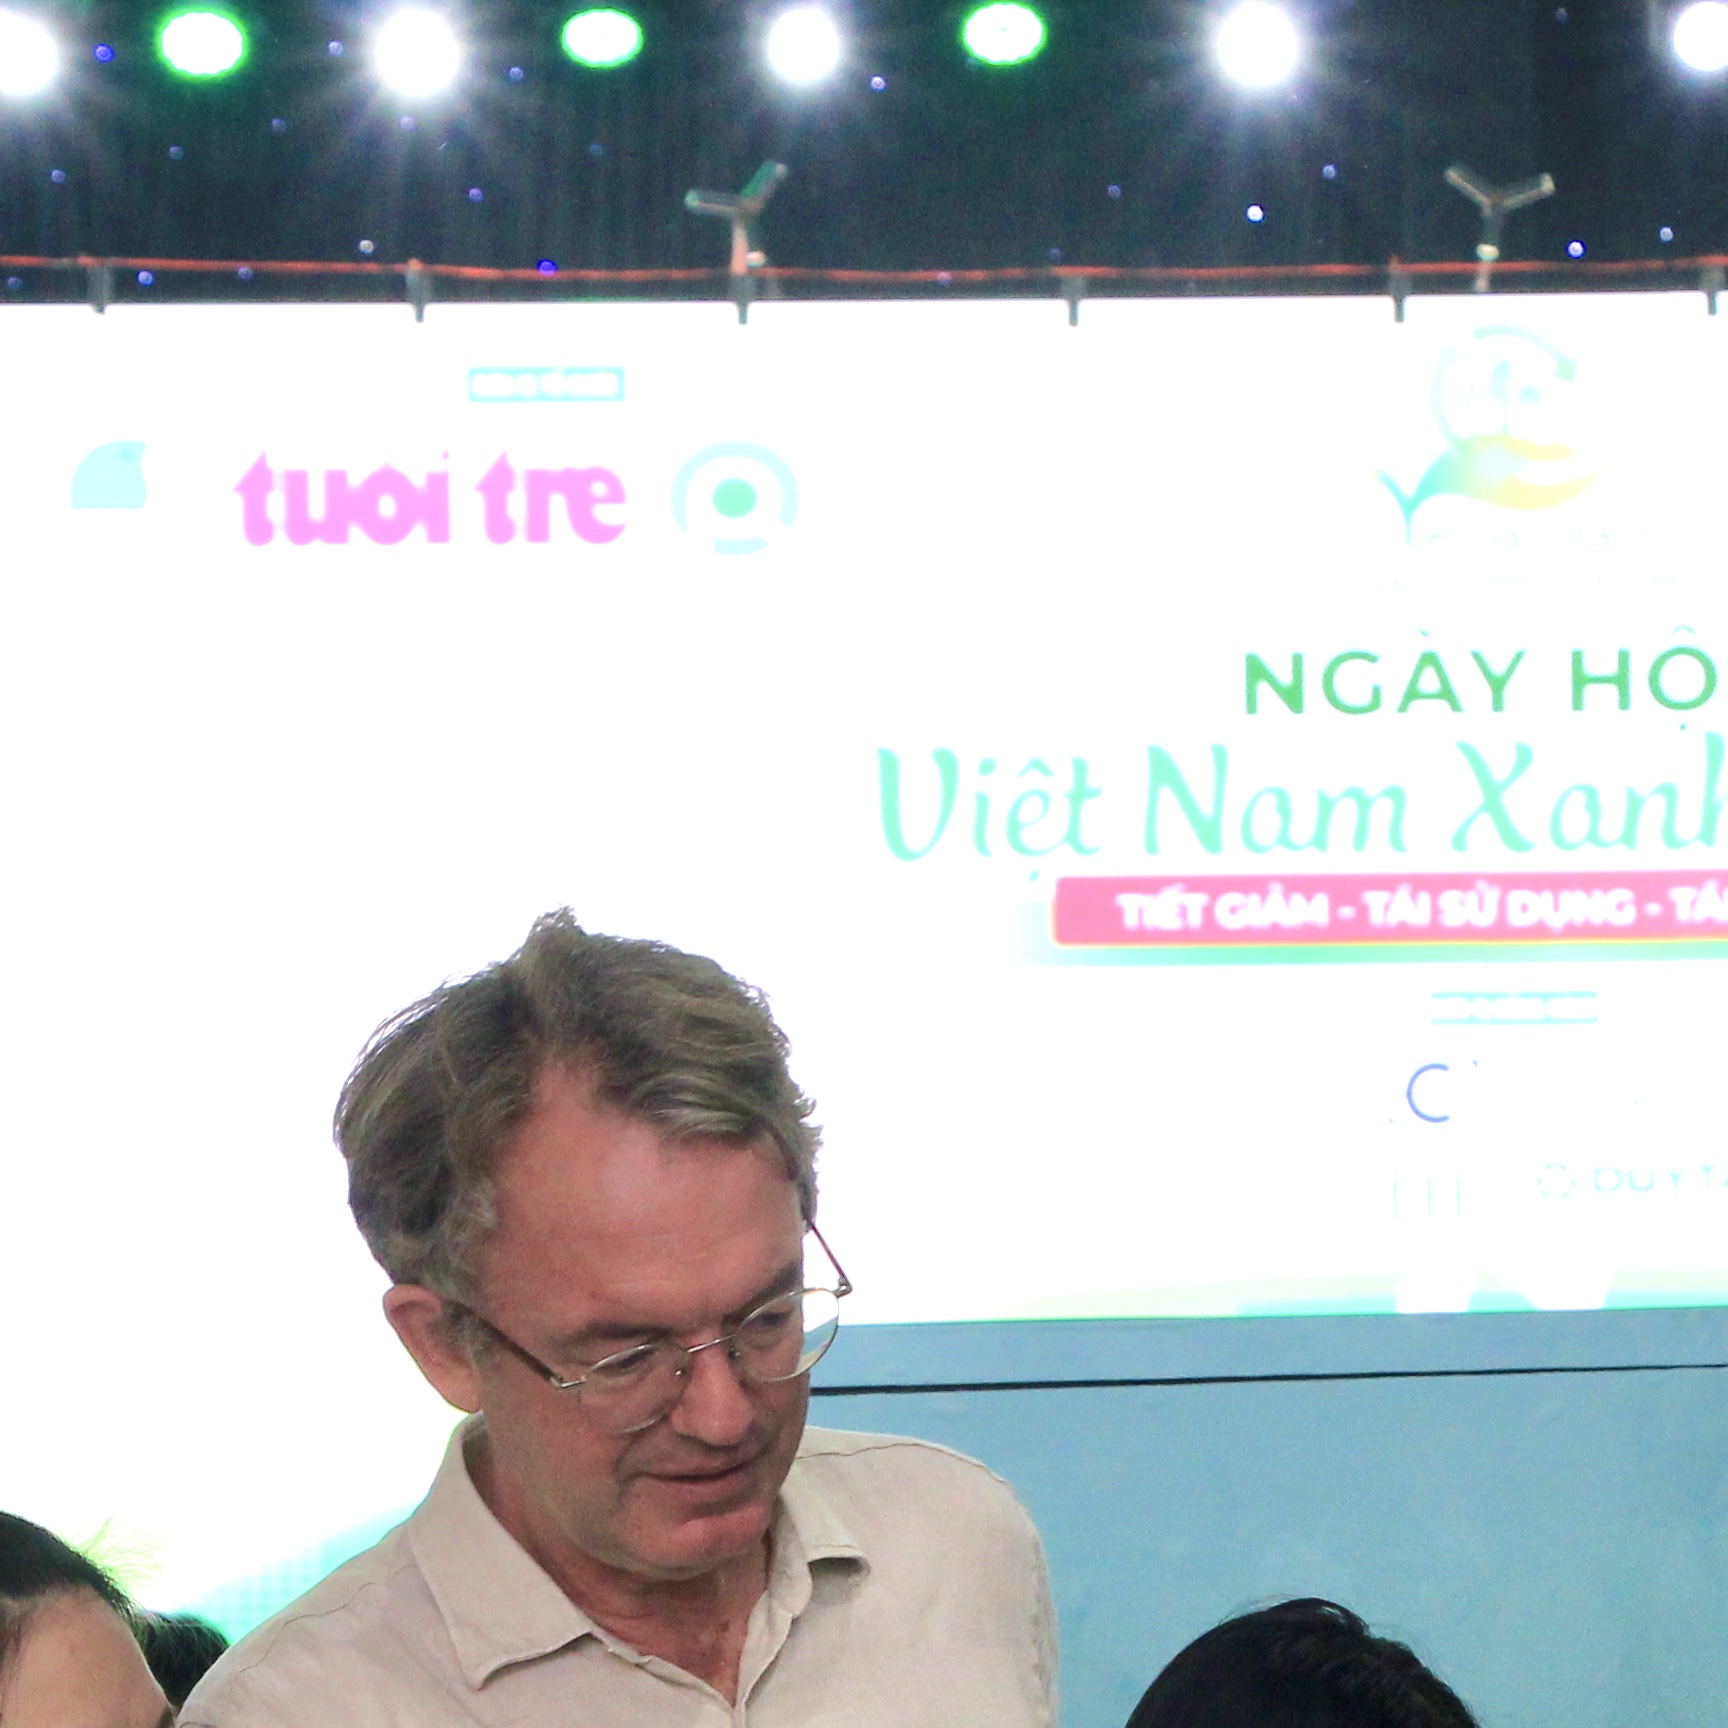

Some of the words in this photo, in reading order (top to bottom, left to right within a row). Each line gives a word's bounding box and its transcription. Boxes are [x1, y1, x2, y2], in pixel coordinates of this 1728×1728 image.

[1143, 742, 1410, 857] Nam
[1118, 883, 1209, 929] TIẾT
[1214, 880, 1329, 929] GIẢM
[1363, 882, 1431, 927] TÁI
[1438, 877, 1499, 927] SỬ
[1507, 887, 1637, 934] DỤNG
